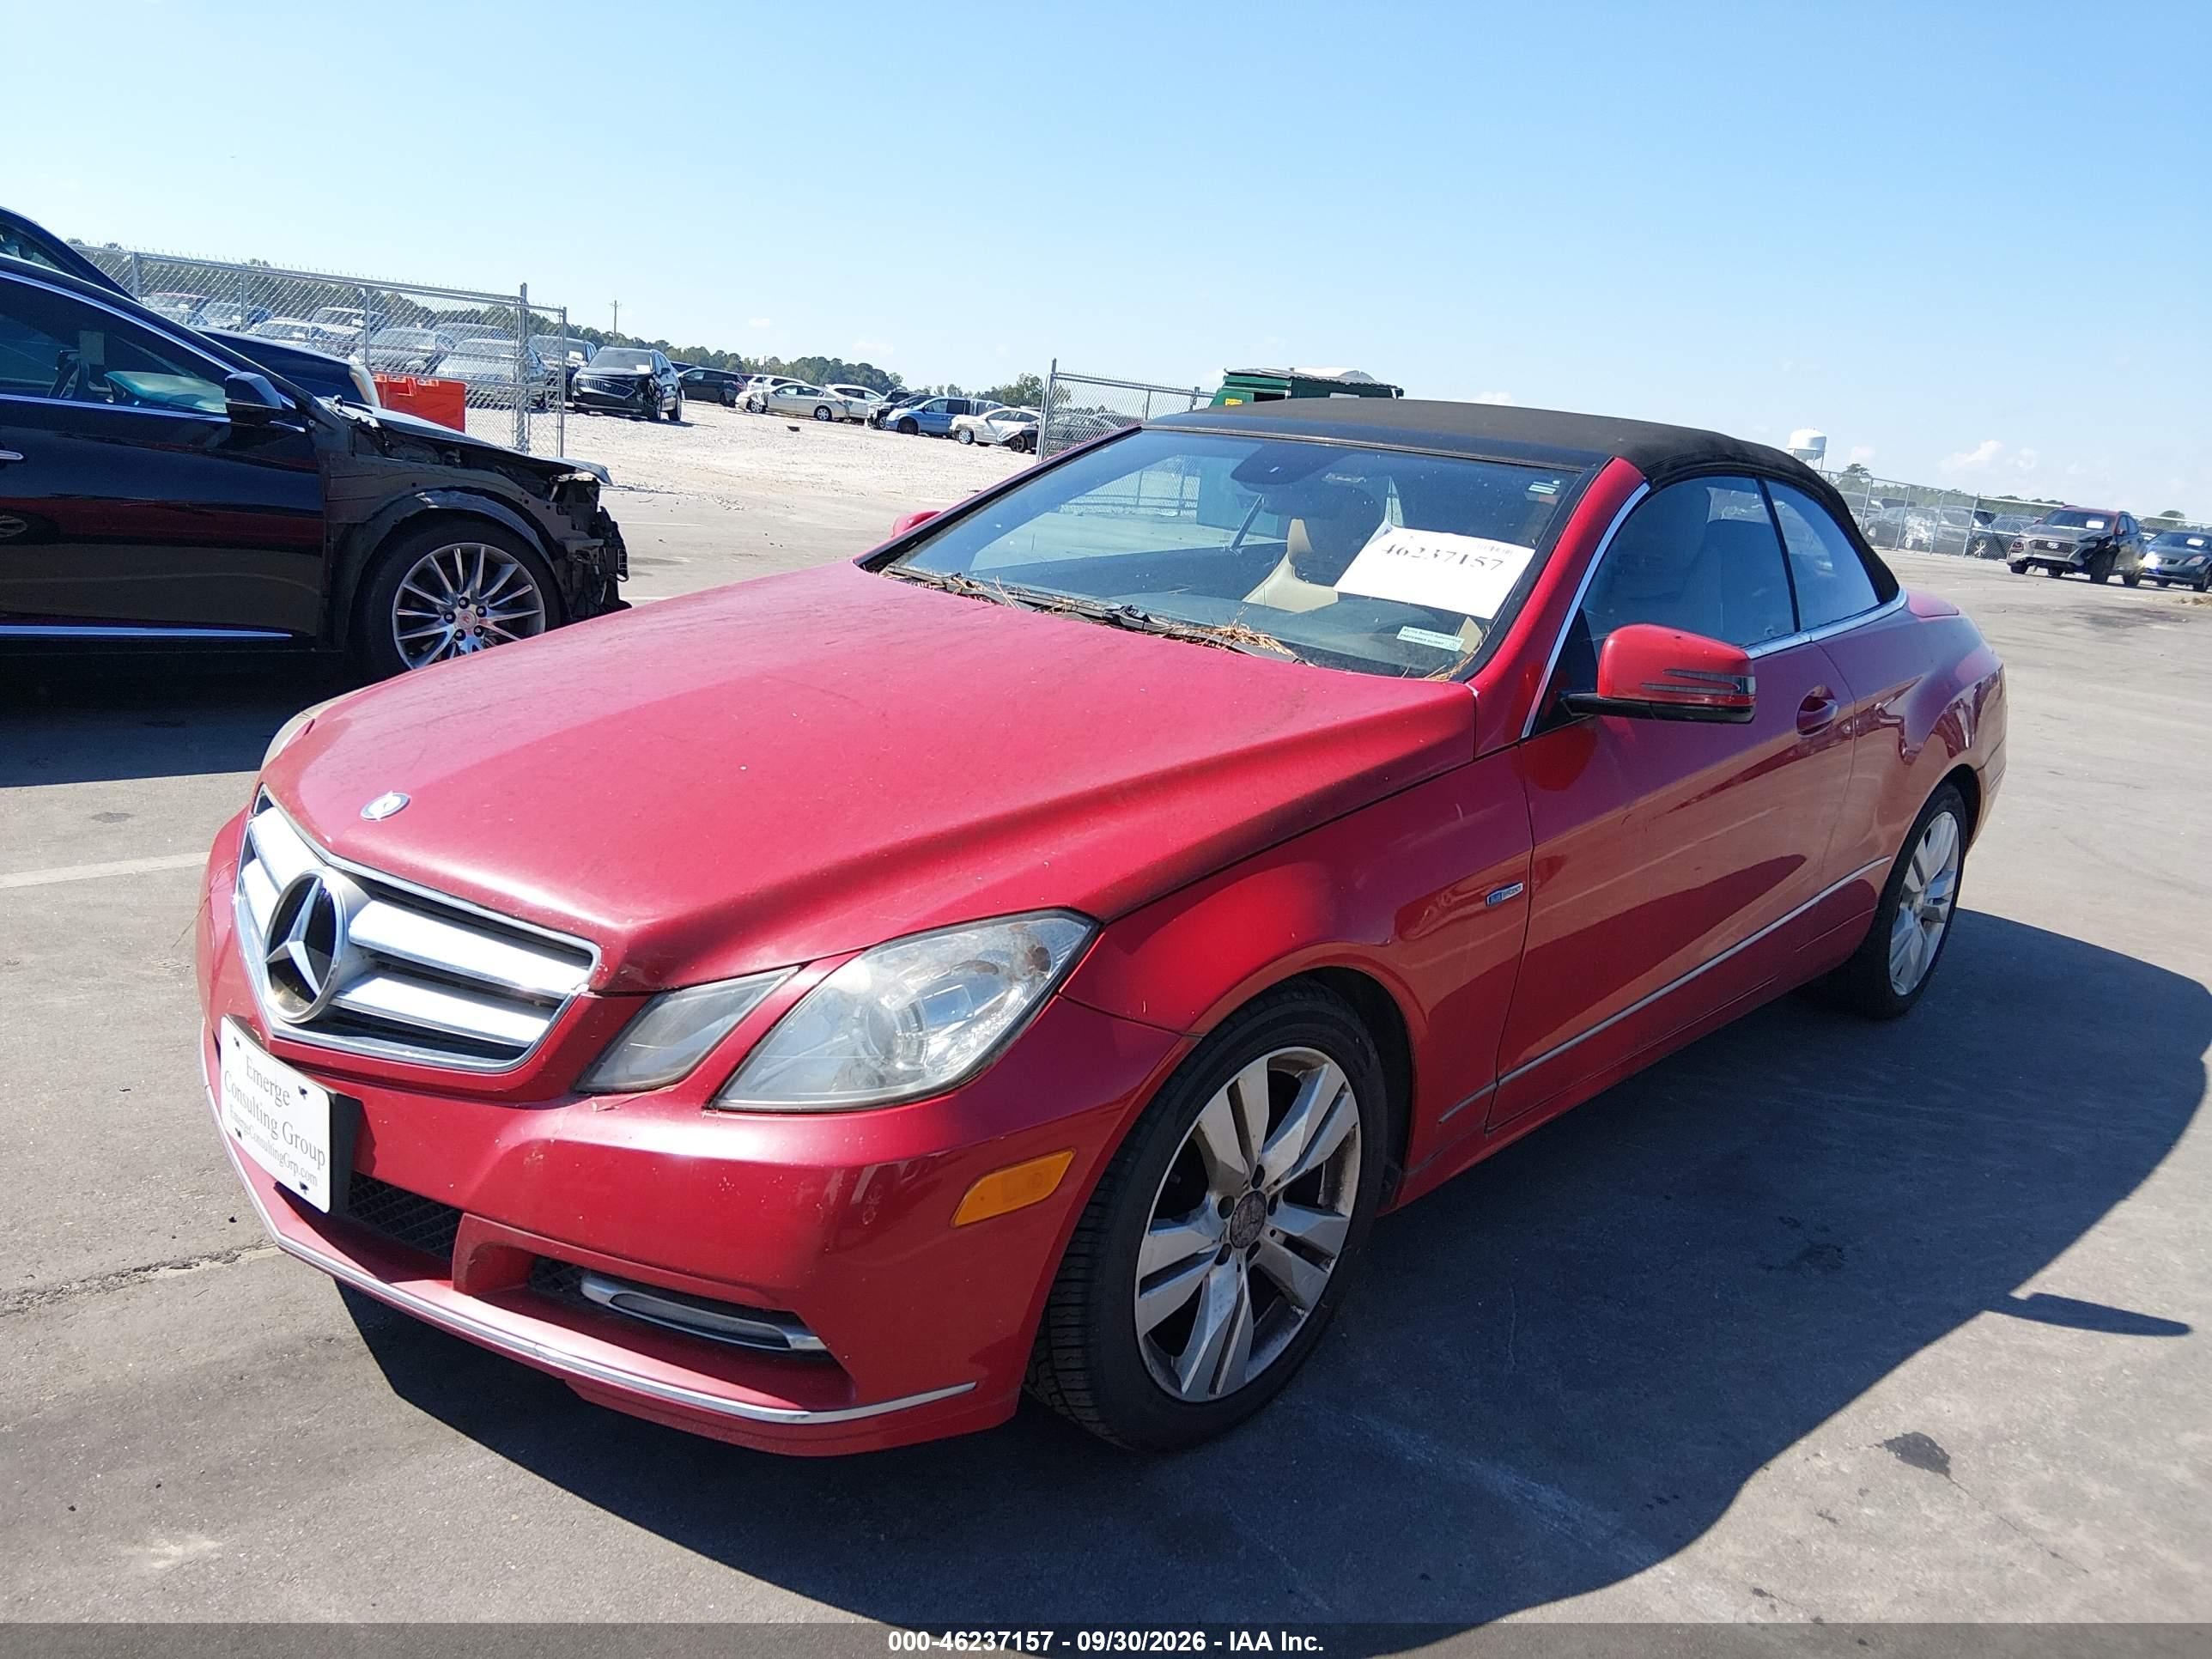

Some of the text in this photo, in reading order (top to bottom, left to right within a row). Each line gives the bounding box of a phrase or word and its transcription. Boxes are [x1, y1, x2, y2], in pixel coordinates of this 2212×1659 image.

[1382, 544, 1504, 571] 46237157
[246, 1054, 290, 1108] Emerge
[224, 1070, 325, 1170] Consulting Group
